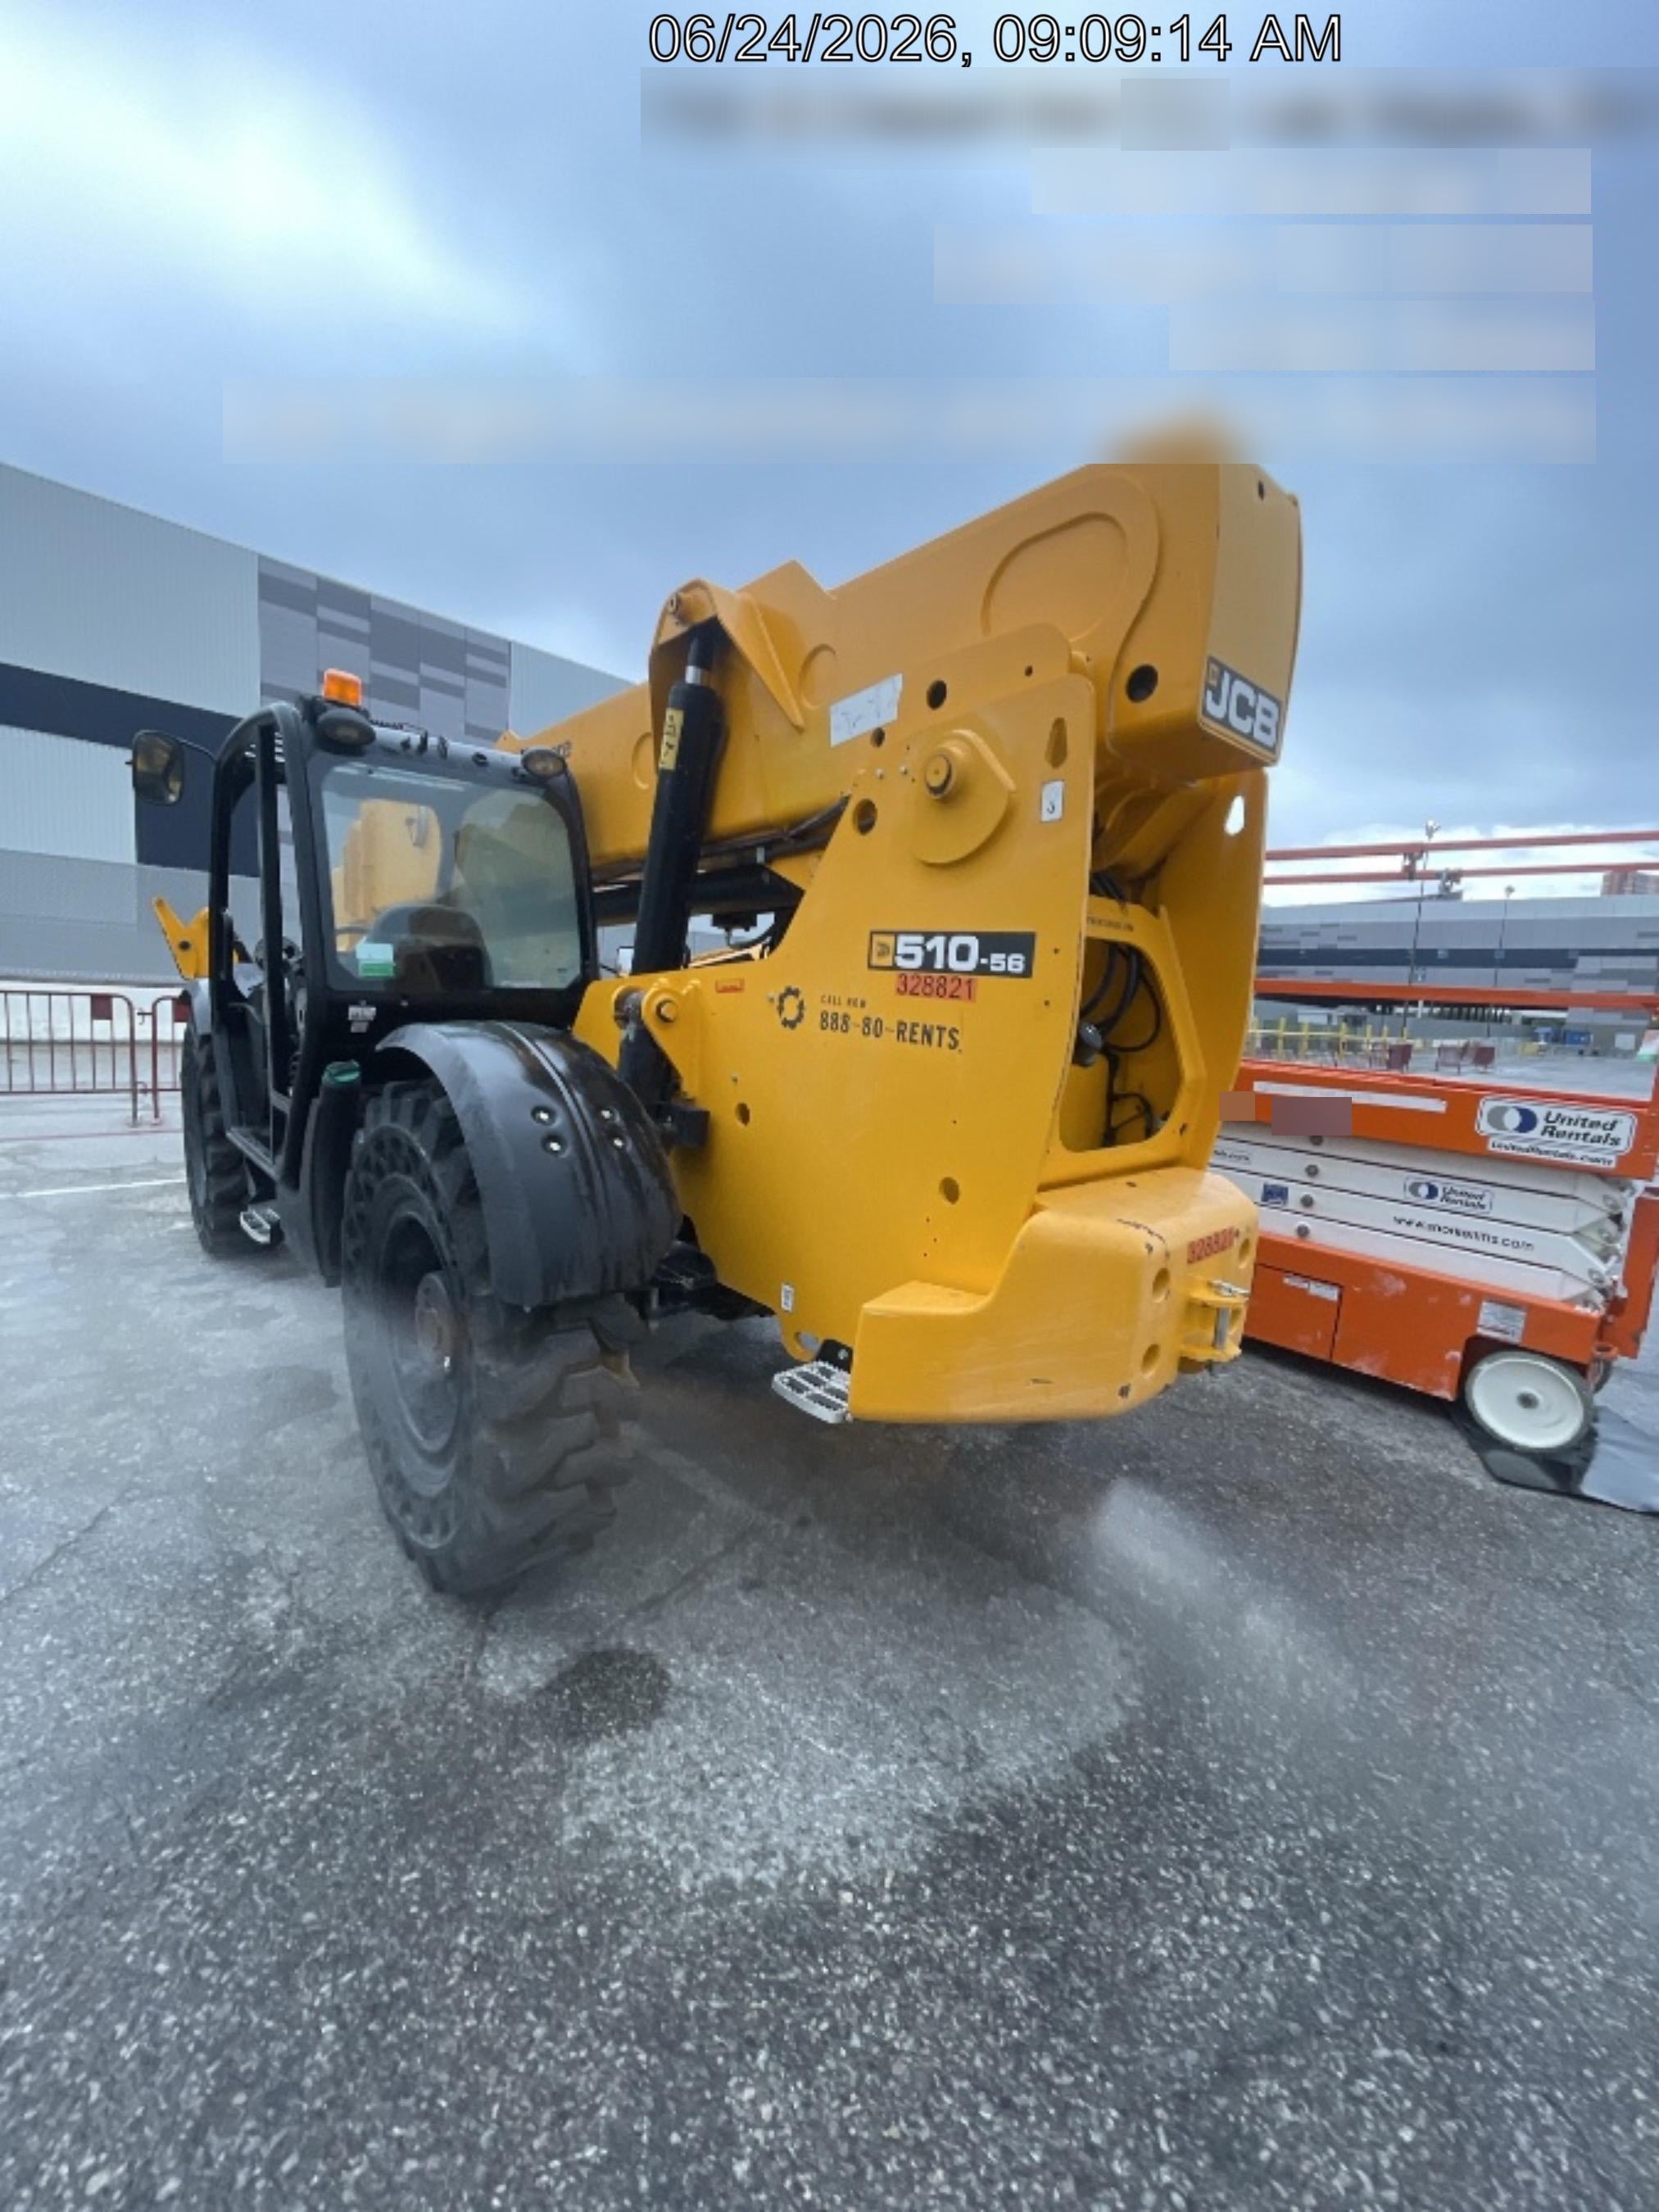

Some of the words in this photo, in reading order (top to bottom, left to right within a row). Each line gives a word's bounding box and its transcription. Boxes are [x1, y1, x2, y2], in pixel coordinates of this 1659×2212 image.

[1205, 669, 1279, 748] JCB
[895, 933, 1025, 974] 510-56
[896, 973, 974, 999] 328821
[1543, 1109, 1619, 1131] United
[1540, 1125, 1621, 1146] Rentals
